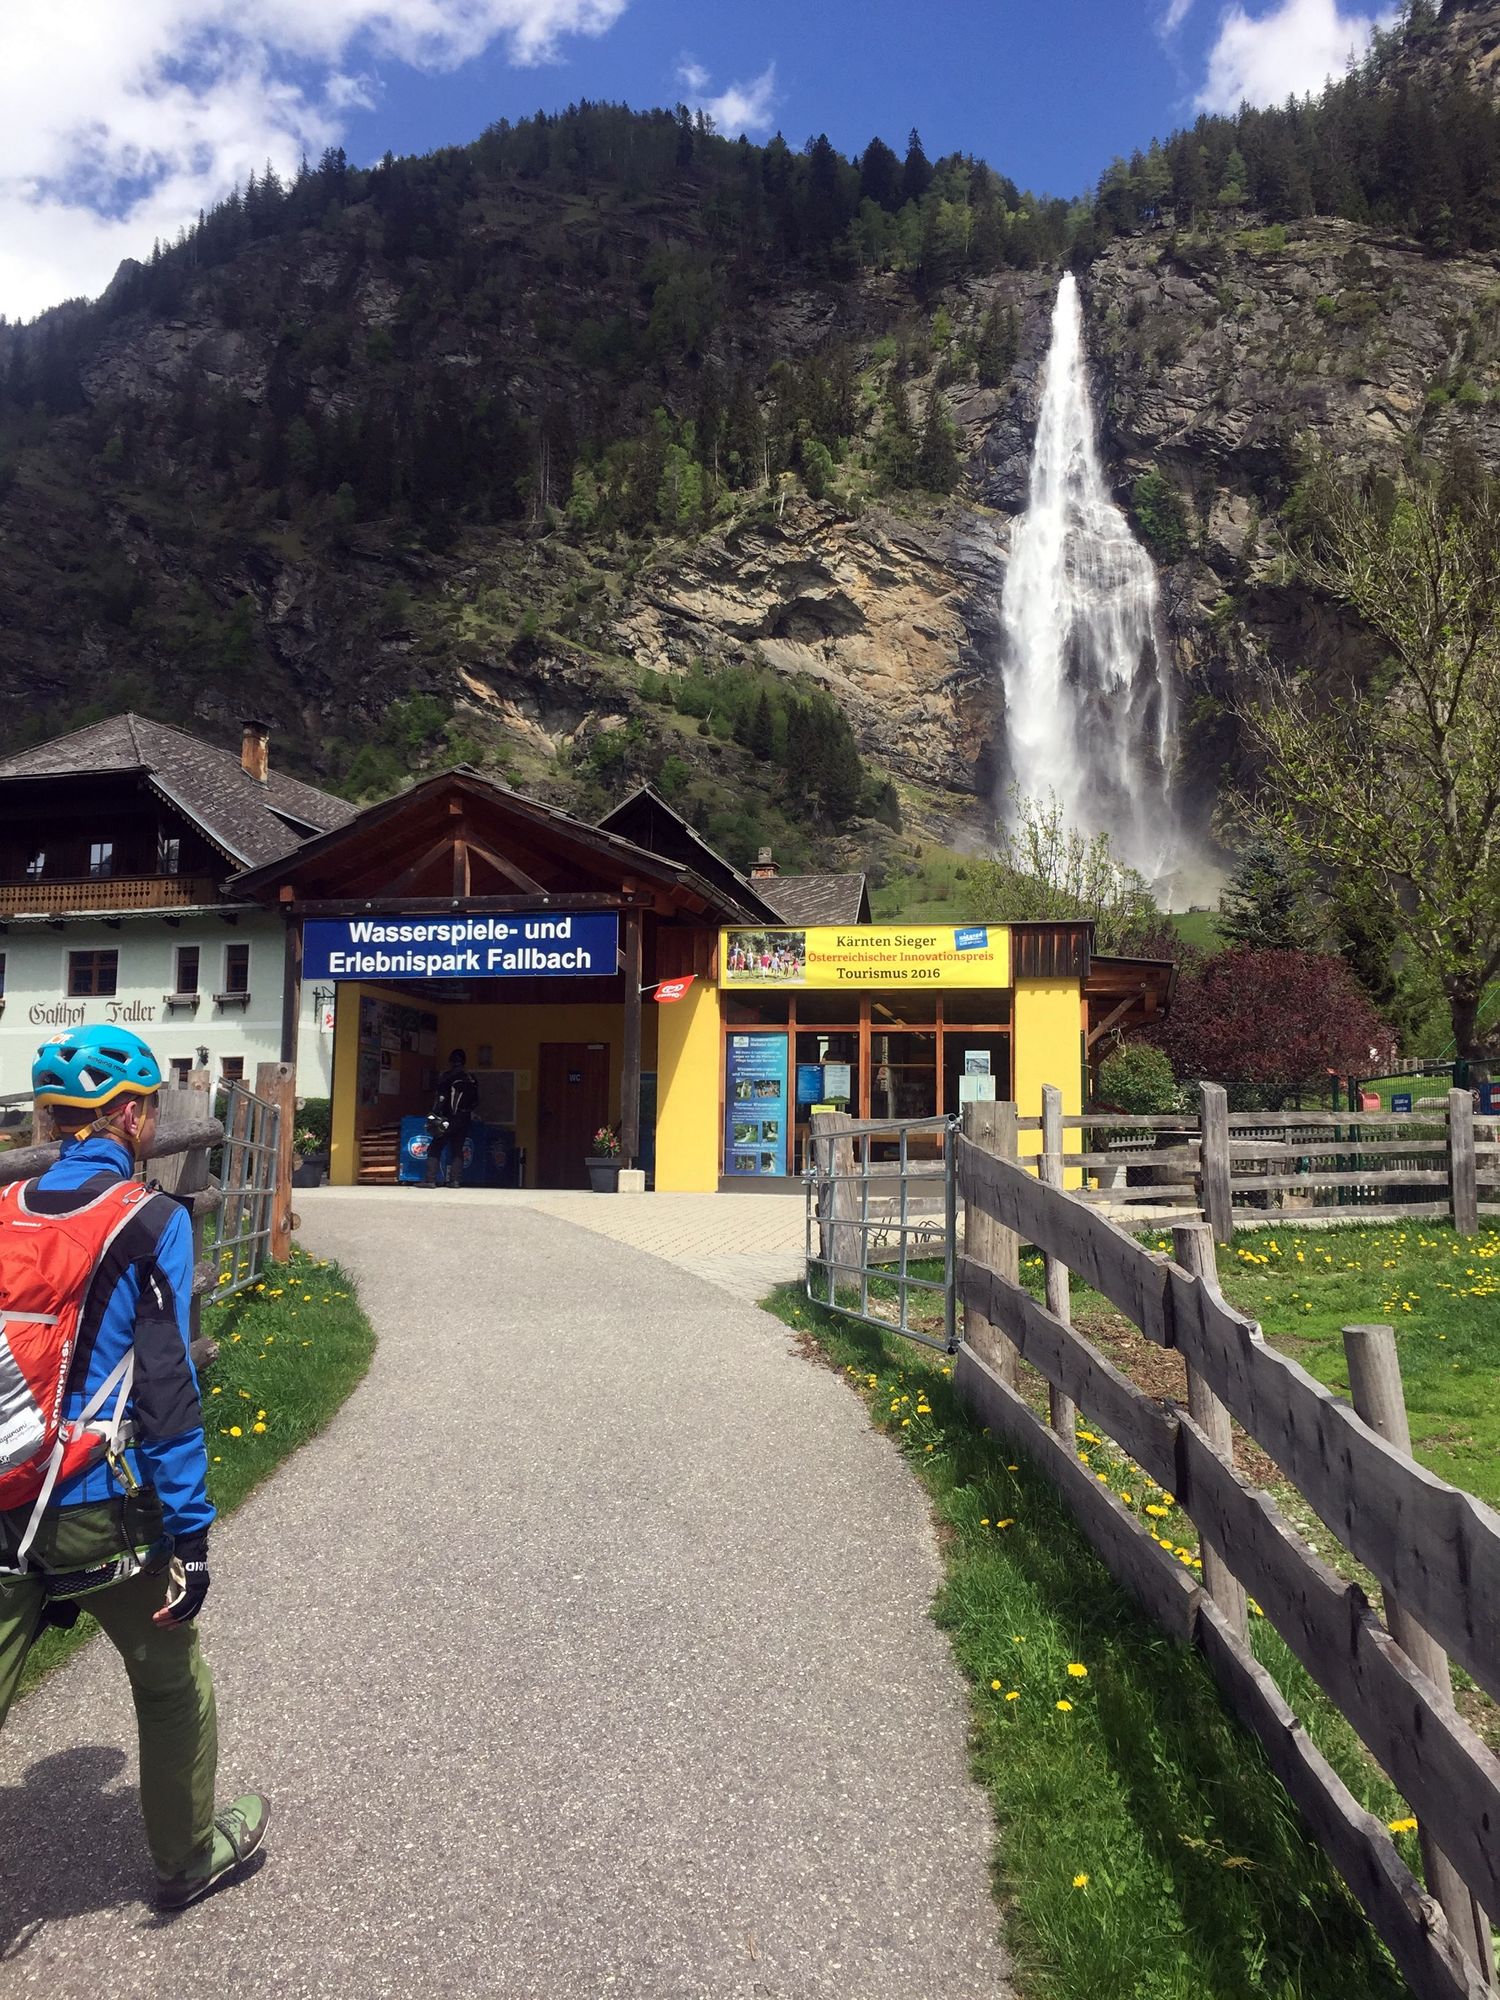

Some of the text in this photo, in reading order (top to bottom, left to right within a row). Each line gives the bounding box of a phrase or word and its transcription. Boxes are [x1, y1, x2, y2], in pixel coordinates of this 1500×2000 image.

[349, 917, 572, 945] Wasserspiele- und
[836, 935, 937, 949] Kärnten Sieger
[329, 947, 591, 975] Erlebnispark Fallbach
[808, 950, 994, 963] Österreichischer Innovationspreis
[836, 967, 941, 979] Tourismus 2016
[105, 1000, 156, 1023] Faller
[569, 1073, 581, 1082] WC
